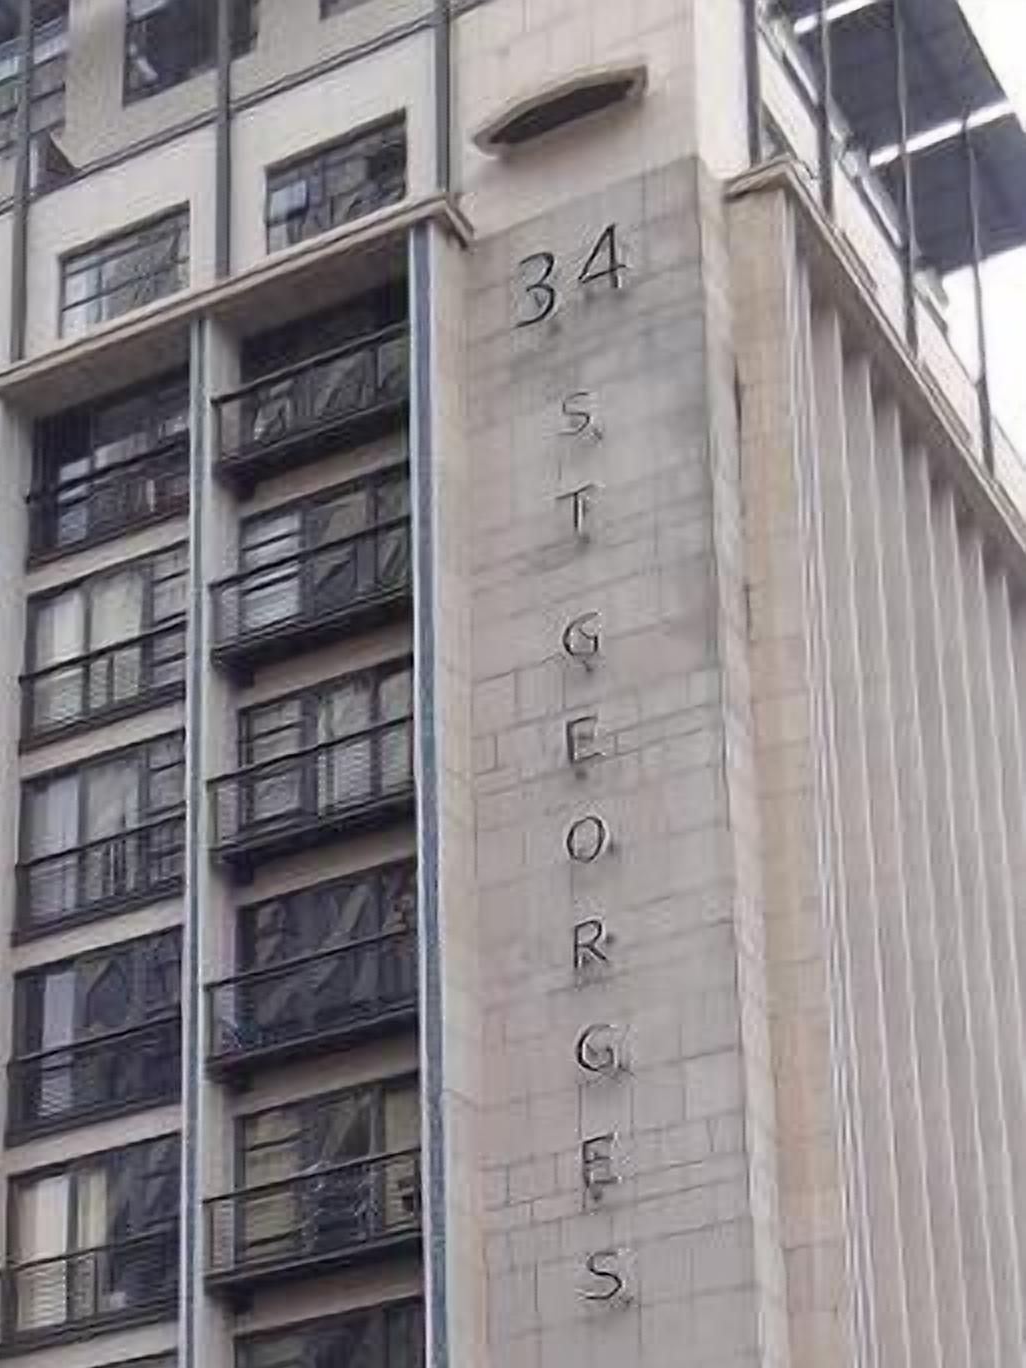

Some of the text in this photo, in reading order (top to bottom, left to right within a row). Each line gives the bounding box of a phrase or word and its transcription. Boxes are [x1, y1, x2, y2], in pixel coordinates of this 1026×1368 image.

[515, 221, 626, 329] 34
[555, 390, 628, 1302] ST GEORGES
